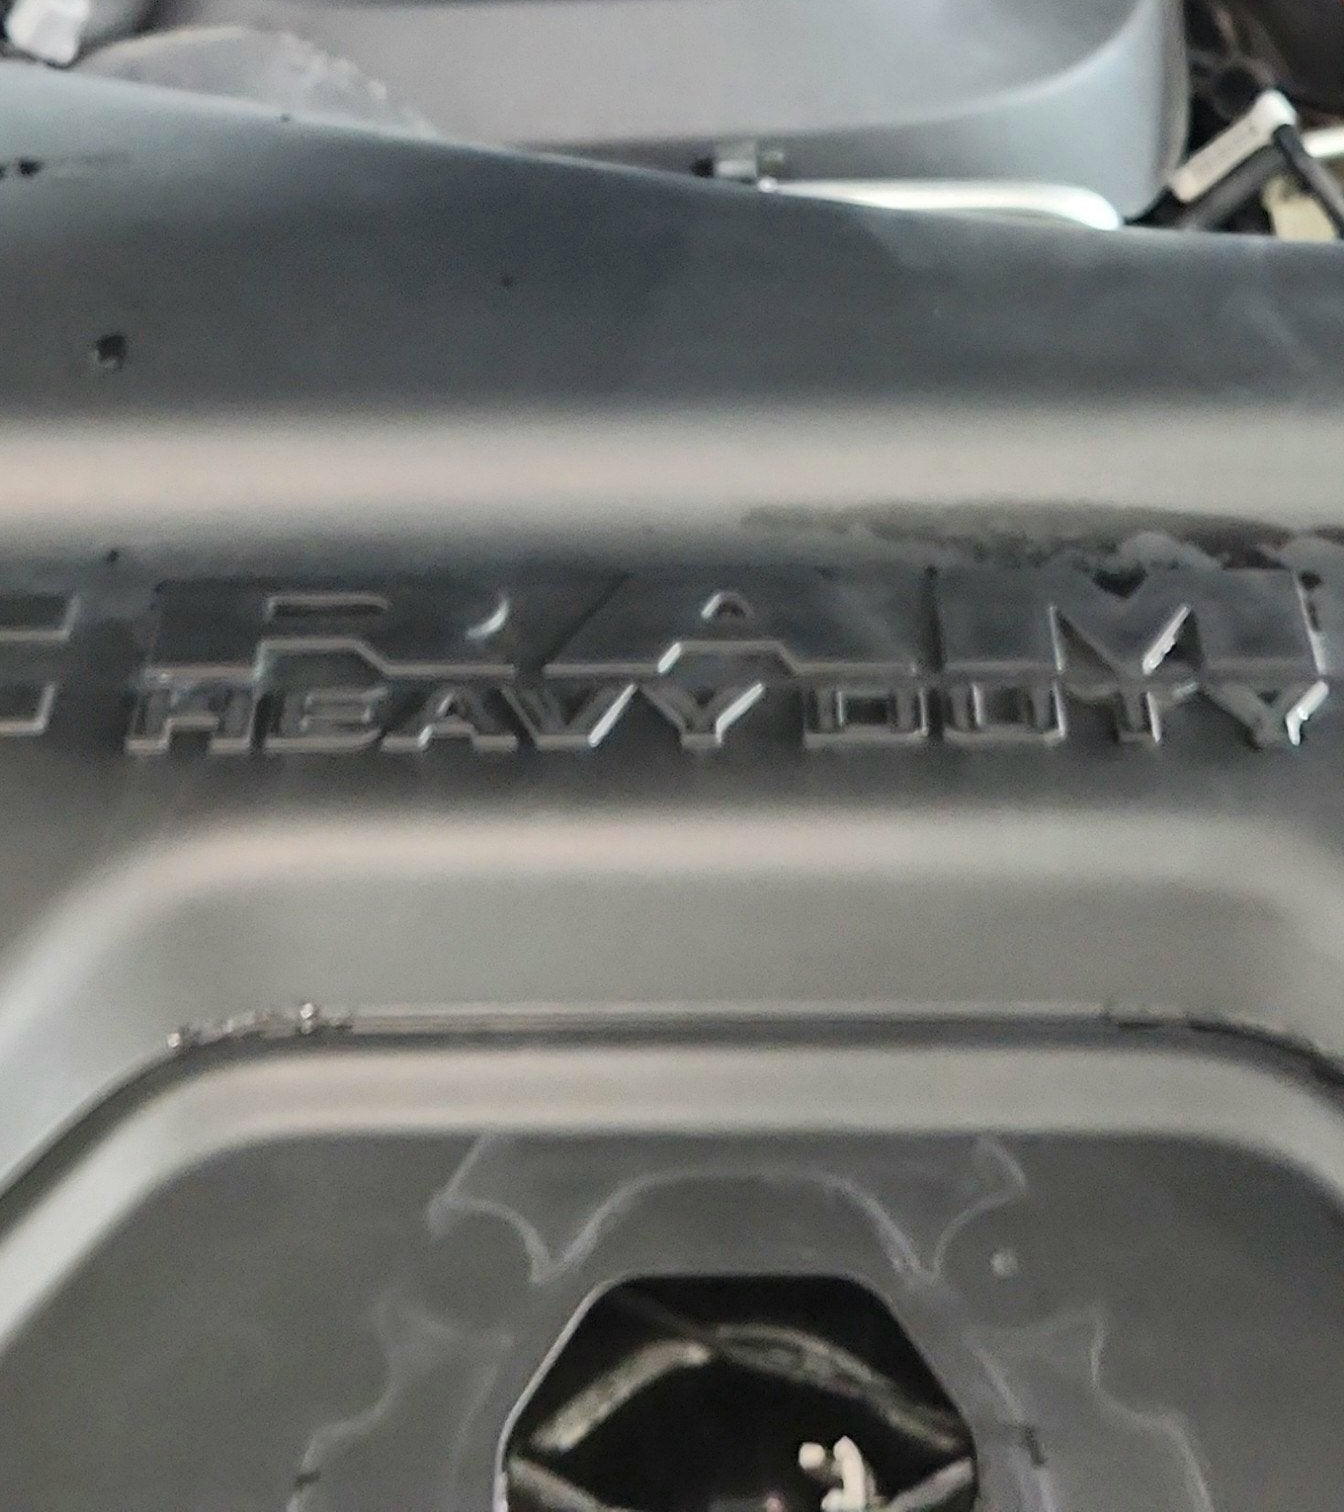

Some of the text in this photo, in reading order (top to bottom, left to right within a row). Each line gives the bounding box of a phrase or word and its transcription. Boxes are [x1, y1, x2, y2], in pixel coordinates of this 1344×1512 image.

[144, 569, 1326, 677] RAM
[126, 679, 1331, 751] HEAVY DUTY
